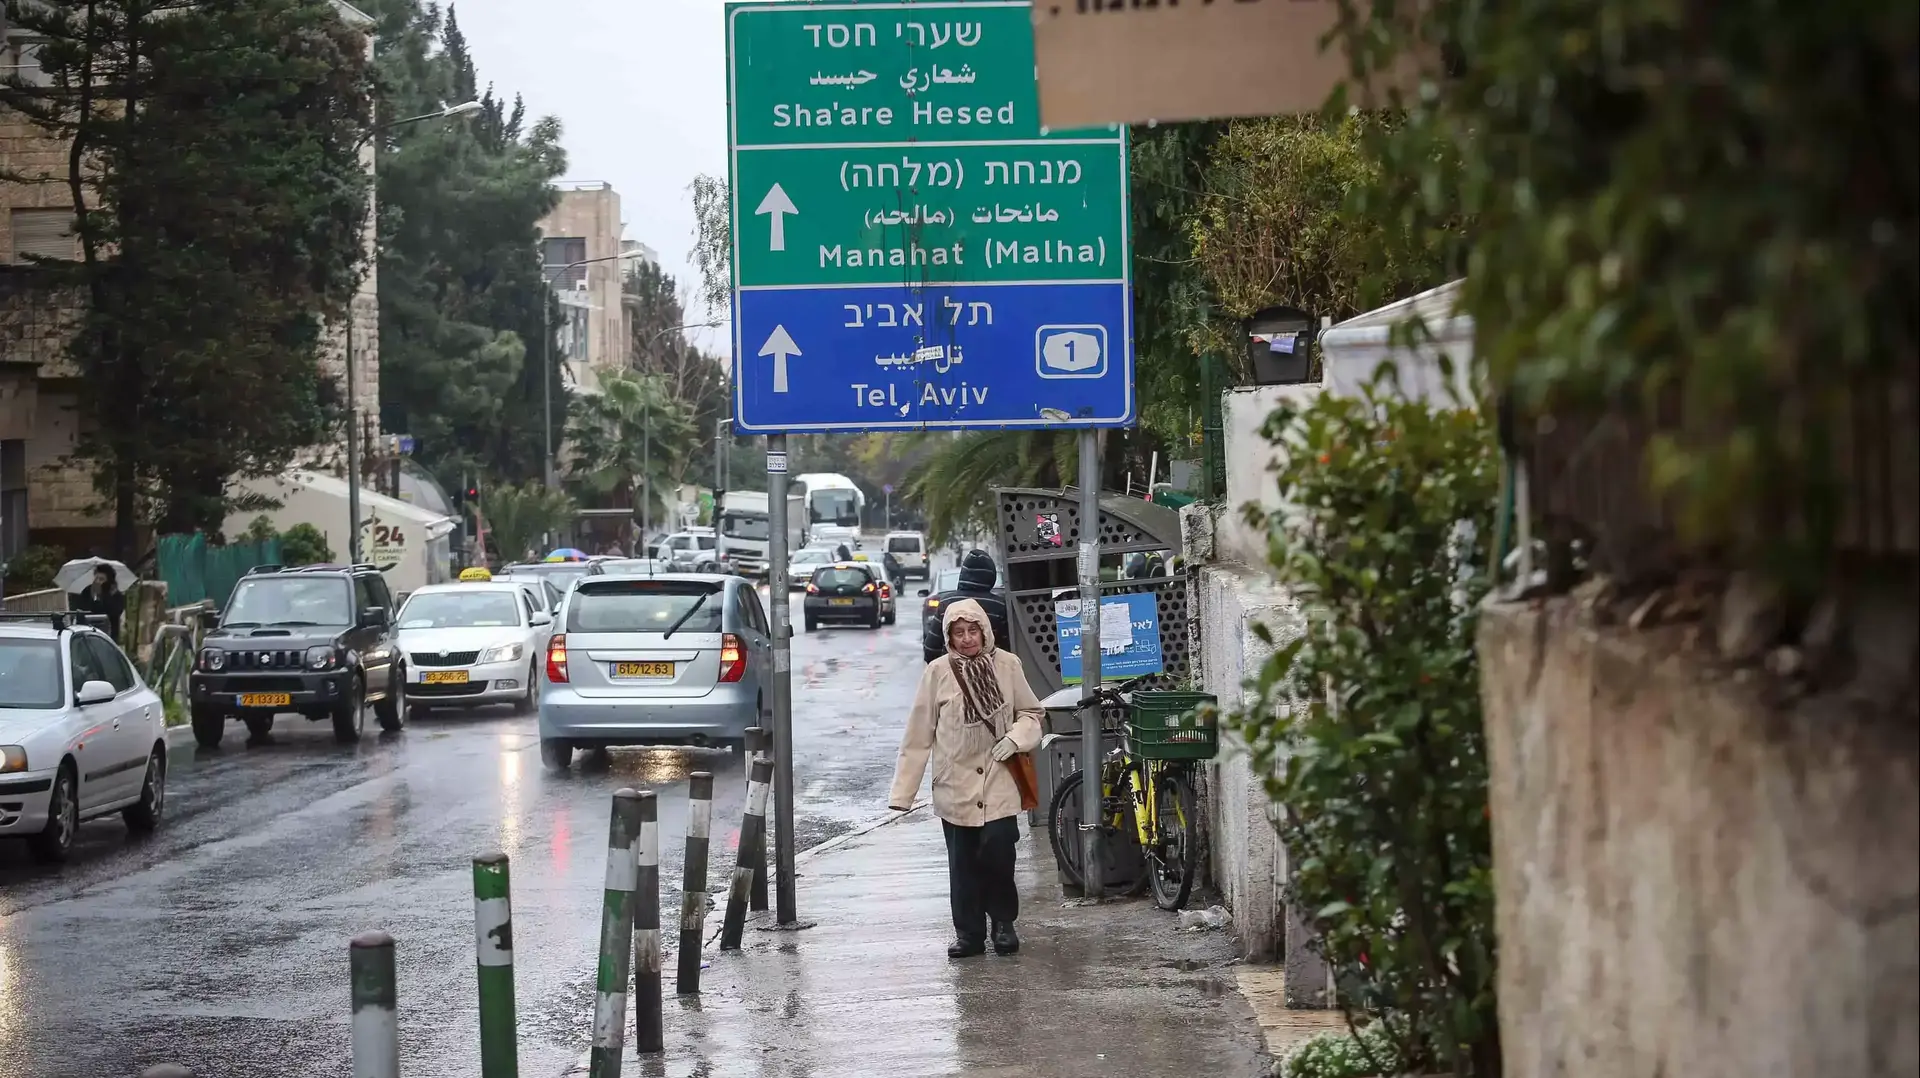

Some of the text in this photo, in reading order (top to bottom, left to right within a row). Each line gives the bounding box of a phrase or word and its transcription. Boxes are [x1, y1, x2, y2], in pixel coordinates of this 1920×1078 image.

[804, 22, 982, 49] שערי חסד
[809, 64, 976, 95] شعاري حيسد
[773, 101, 1014, 127] Sha'are Hesed
[840, 156, 1082, 191] מנחת (מלחה)
[972, 203, 1059, 223] مانحات
[819, 237, 1106, 268] Manahat (Malha)
[844, 296, 993, 328] תל אביב
[934, 344, 964, 374] تل
[1064, 340, 1075, 362] 1
[851, 381, 988, 407] Tel Aviv
[375, 526, 404, 547] 24
